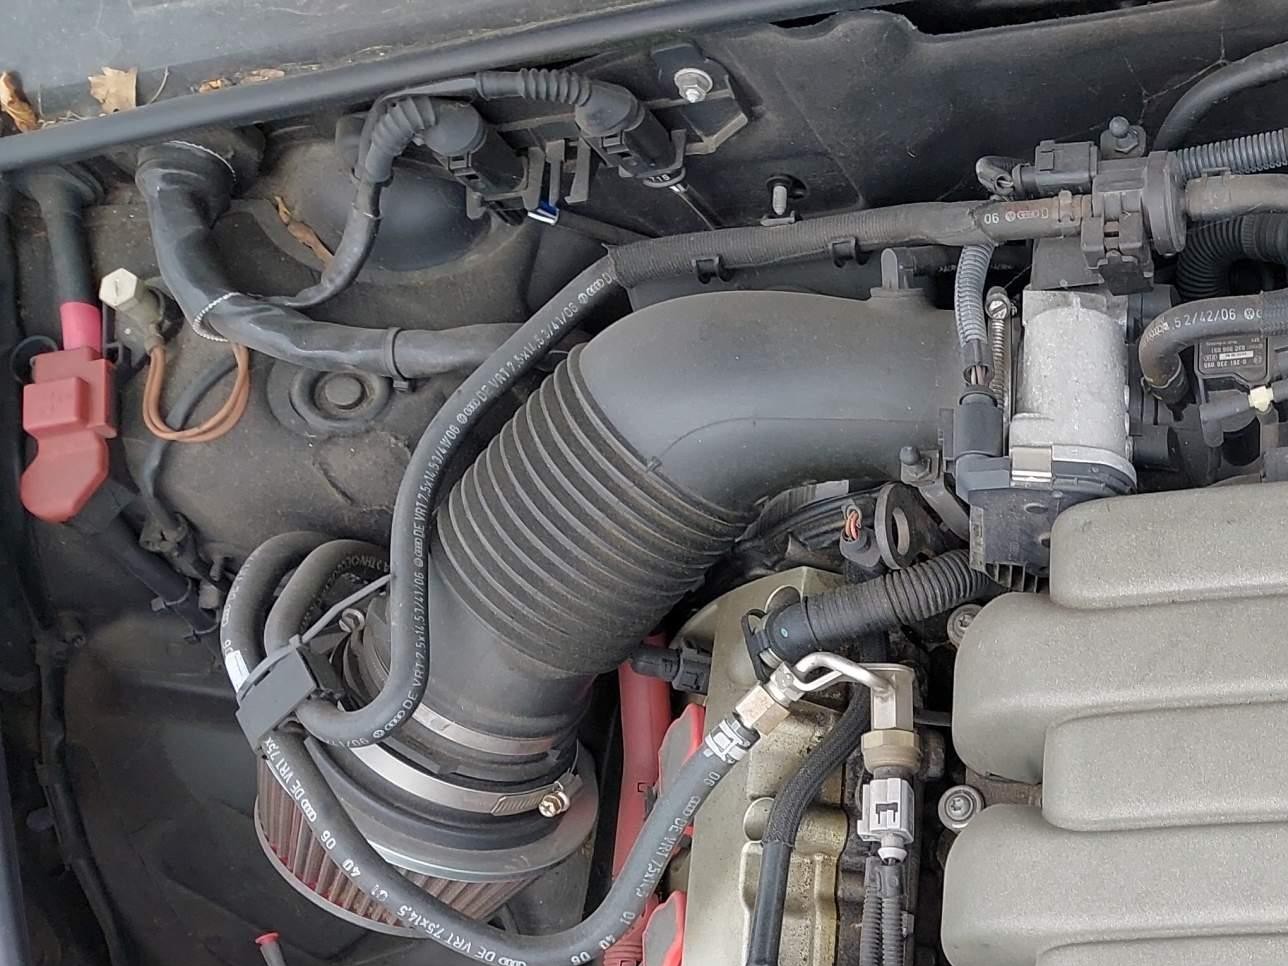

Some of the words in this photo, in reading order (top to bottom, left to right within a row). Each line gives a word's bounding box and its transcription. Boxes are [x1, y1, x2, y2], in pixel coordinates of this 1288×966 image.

[984, 212, 999, 224] 06
[414, 500, 428, 520] VRT
[413, 521, 425, 538] DE
[402, 689, 418, 710] DE
[412, 661, 425, 687] VRT
[274, 757, 293, 783] VRT
[288, 779, 305, 800] DE
[320, 830, 337, 850] 06
[342, 858, 361, 878] 40
[395, 902, 445, 939] 7,5x14,5
[444, 931, 473, 953] VRT
[599, 934, 616, 950] 40
[474, 944, 496, 964] DE
[571, 951, 591, 965] 06
